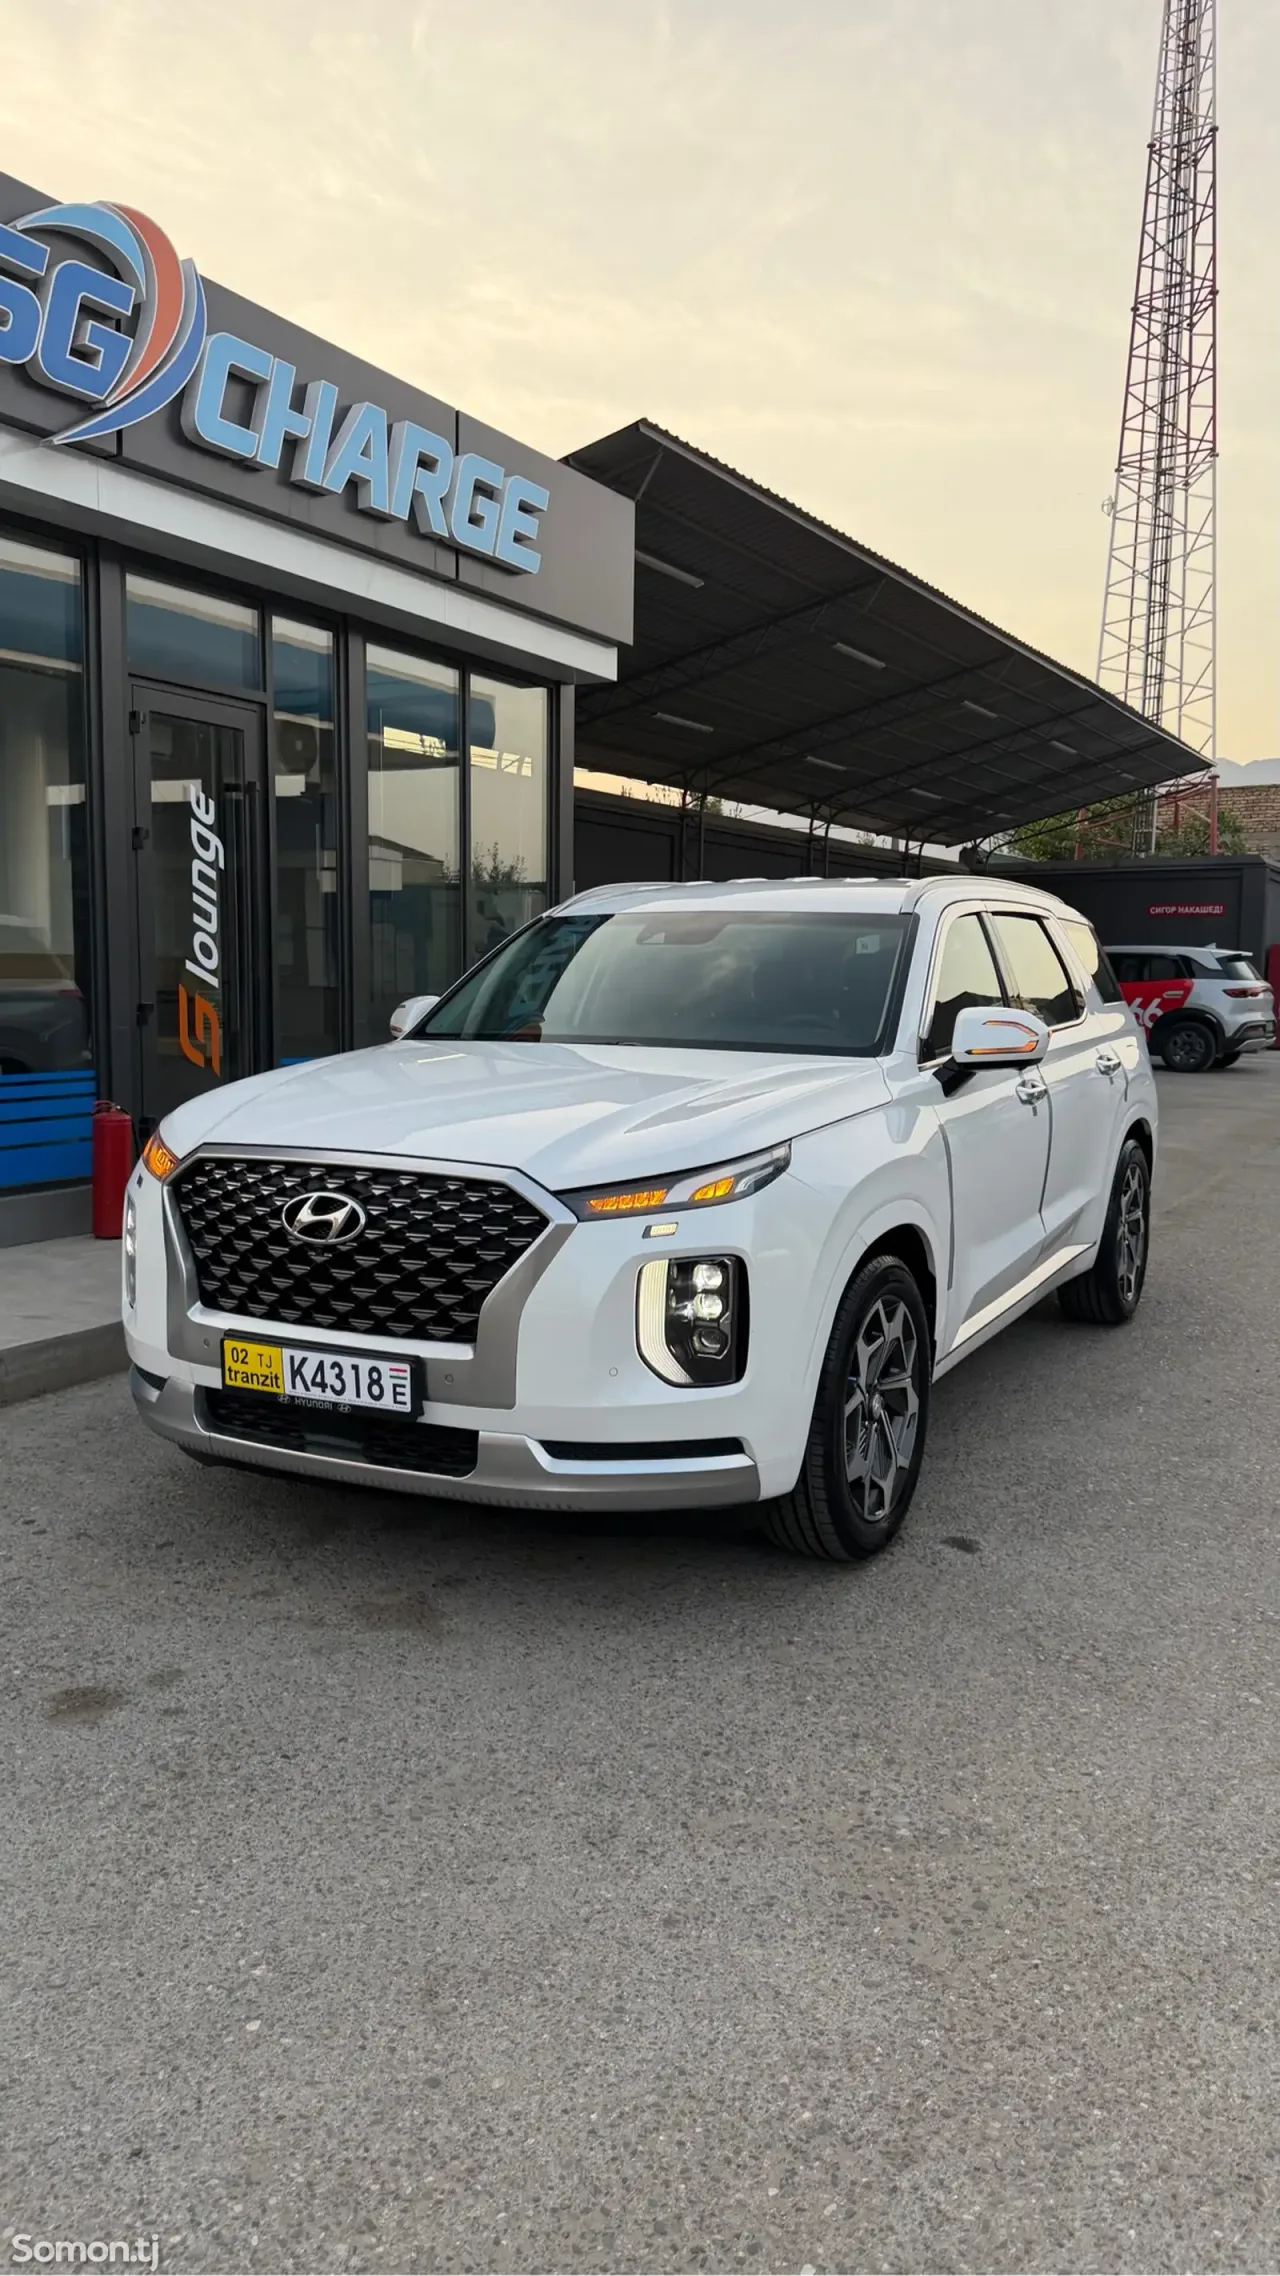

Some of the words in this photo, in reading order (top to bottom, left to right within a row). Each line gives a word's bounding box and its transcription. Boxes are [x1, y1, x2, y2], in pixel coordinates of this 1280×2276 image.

[194, 332, 550, 574] CHARGE
[185, 784, 225, 988] lounge
[227, 1366, 281, 1389] tranzit
[231, 1347, 249, 1365] 02
[257, 1353, 273, 1369] TJ
[289, 1355, 385, 1402] K4318
[393, 1383, 408, 1406] E
